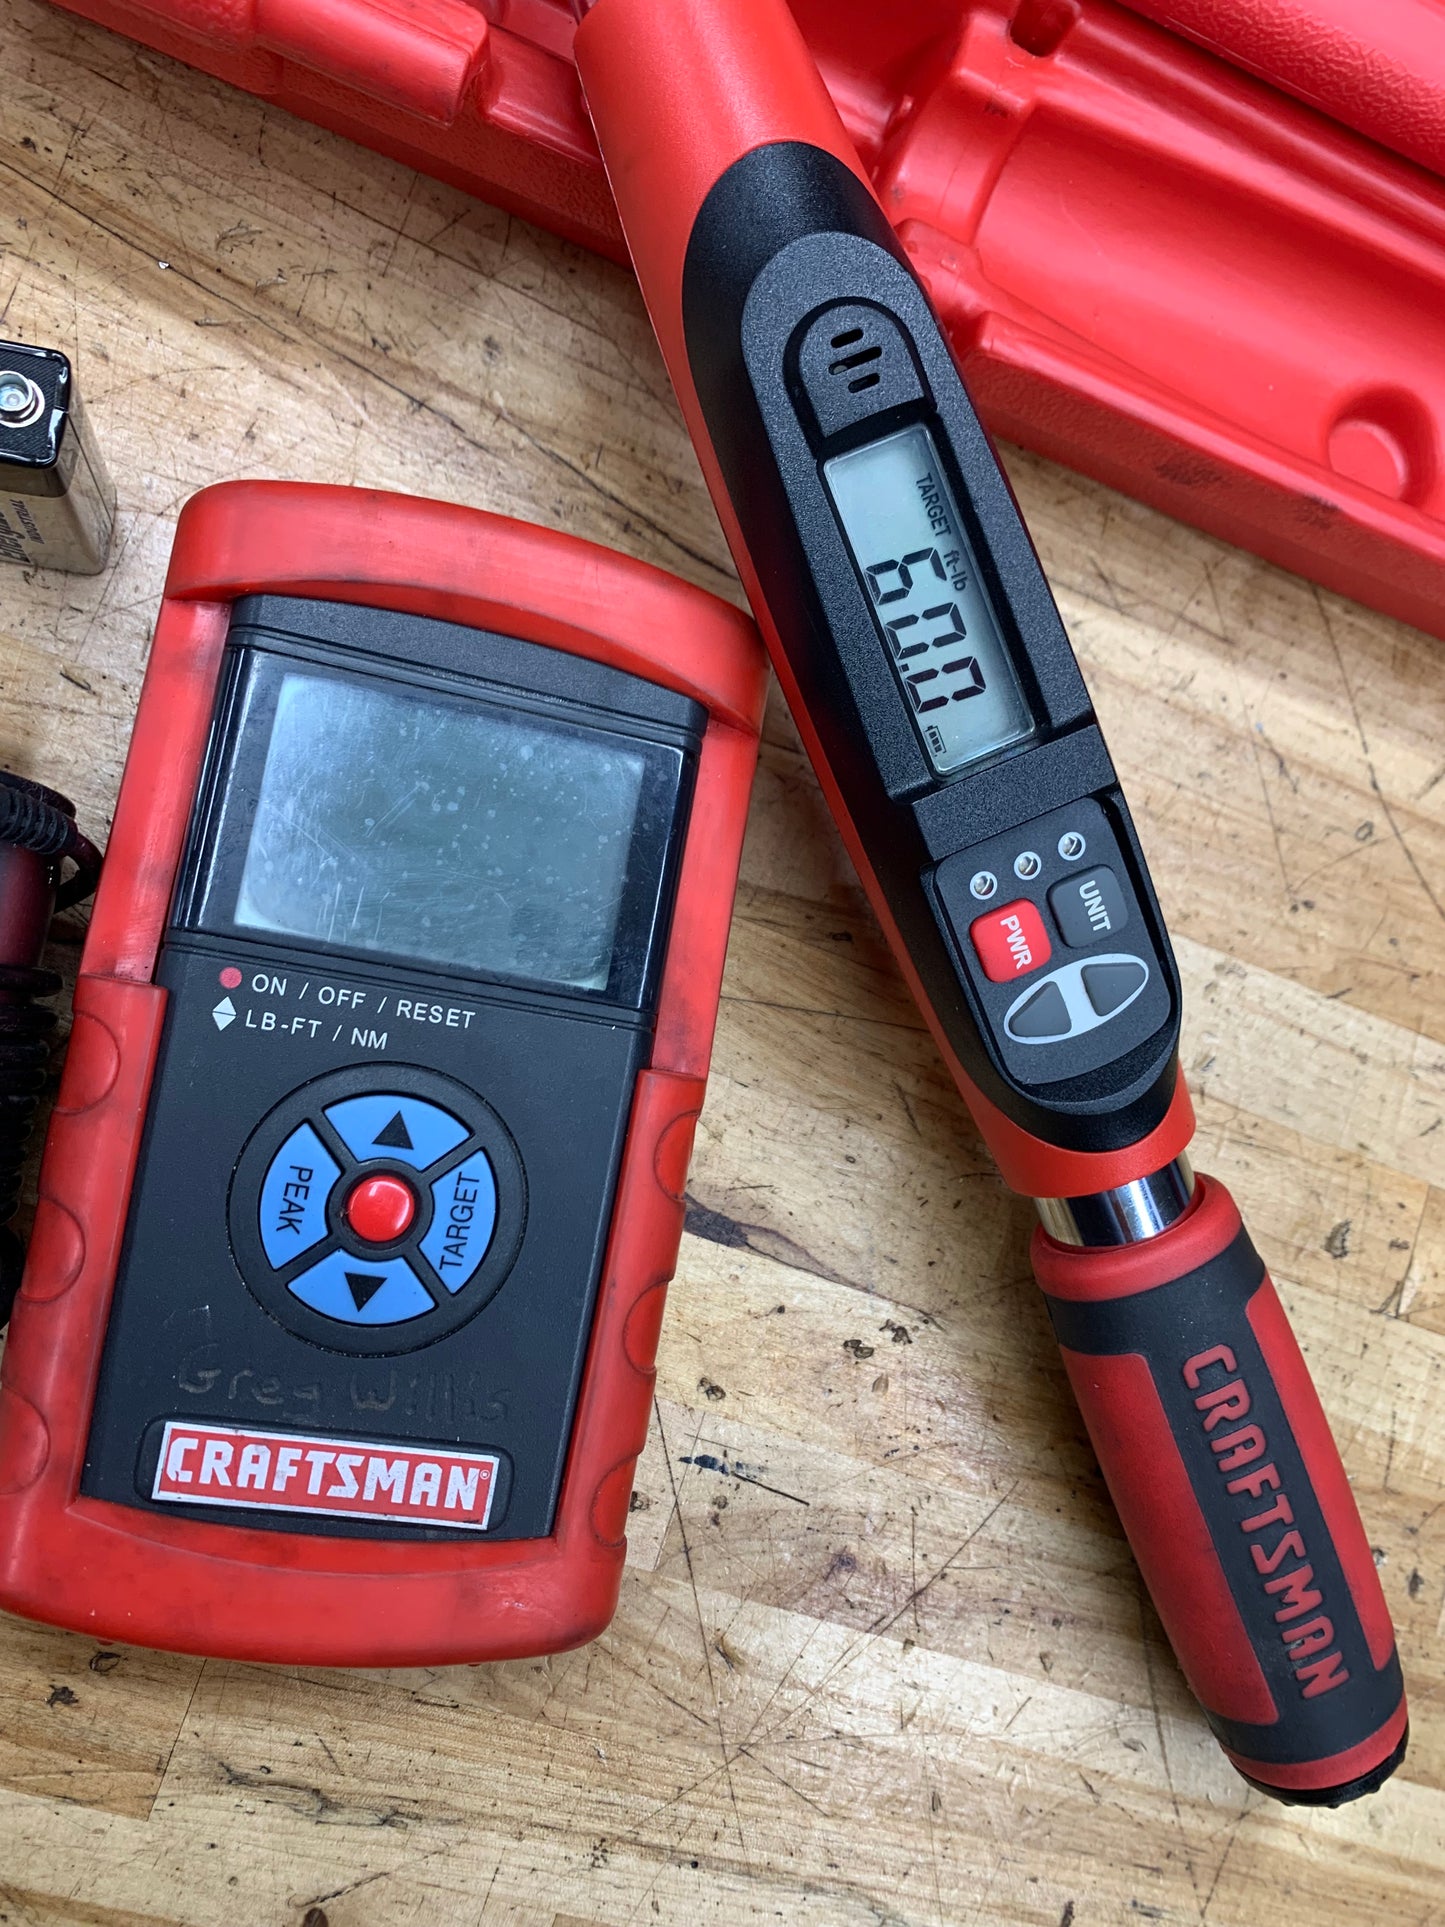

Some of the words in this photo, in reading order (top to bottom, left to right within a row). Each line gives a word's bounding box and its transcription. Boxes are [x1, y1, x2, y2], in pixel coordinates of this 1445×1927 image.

[916, 472, 951, 537] TARGET
[943, 549, 968, 592] ft-lb
[865, 547, 987, 713] 60.0
[1079, 880, 1111, 931] UNIT
[1000, 914, 1032, 970] PWR
[245, 1009, 322, 1038] LB-FT
[351, 1027, 389, 1050] NM
[251, 973, 287, 996] ON
[317, 986, 367, 1009] OFF
[396, 999, 476, 1029] RESET
[275, 1165, 313, 1235] PEAK
[439, 1171, 480, 1270] TARGET
[1182, 1343, 1350, 1700] CRAFTSMAN
